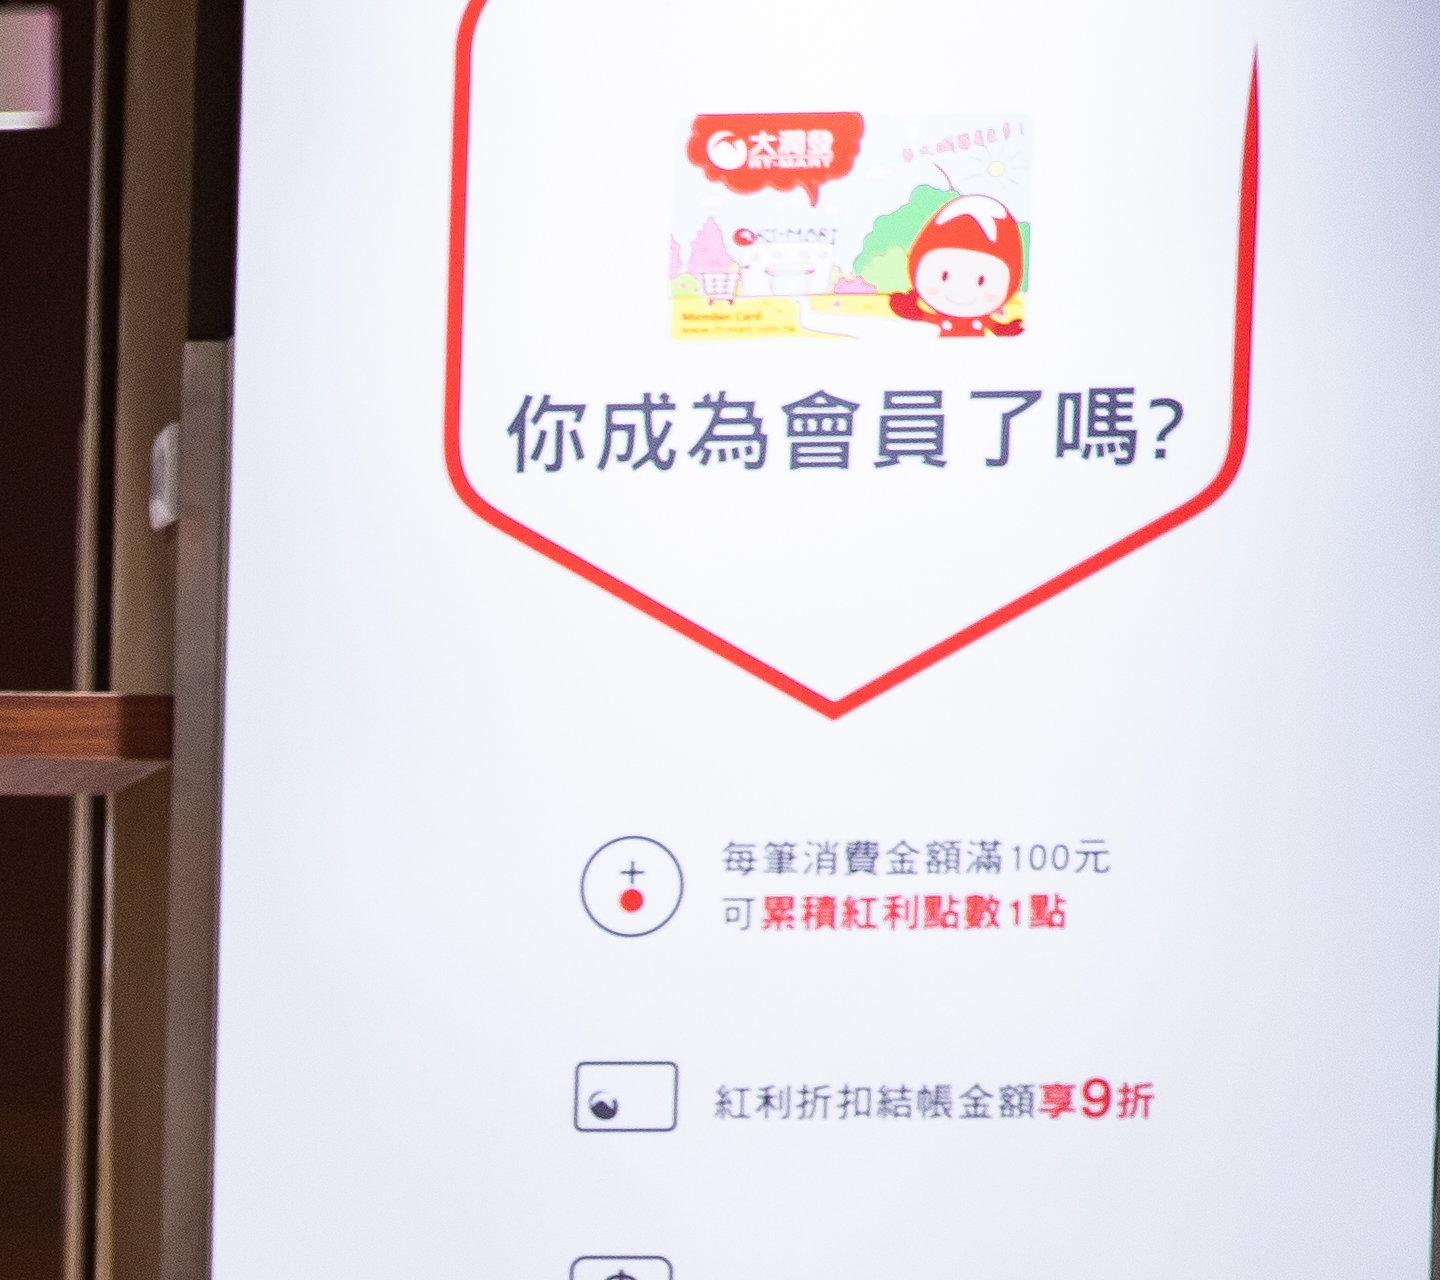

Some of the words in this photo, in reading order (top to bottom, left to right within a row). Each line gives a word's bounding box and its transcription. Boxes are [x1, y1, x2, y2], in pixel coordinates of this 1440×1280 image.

[506, 387, 1186, 476] 你成為會員了嗎?
[723, 839, 1111, 876] 每筆消費金額滿100元
[723, 892, 1067, 931] 可累積紅利點數1點
[714, 1075, 1156, 1121] 紅利折扣結帳金額享9折
